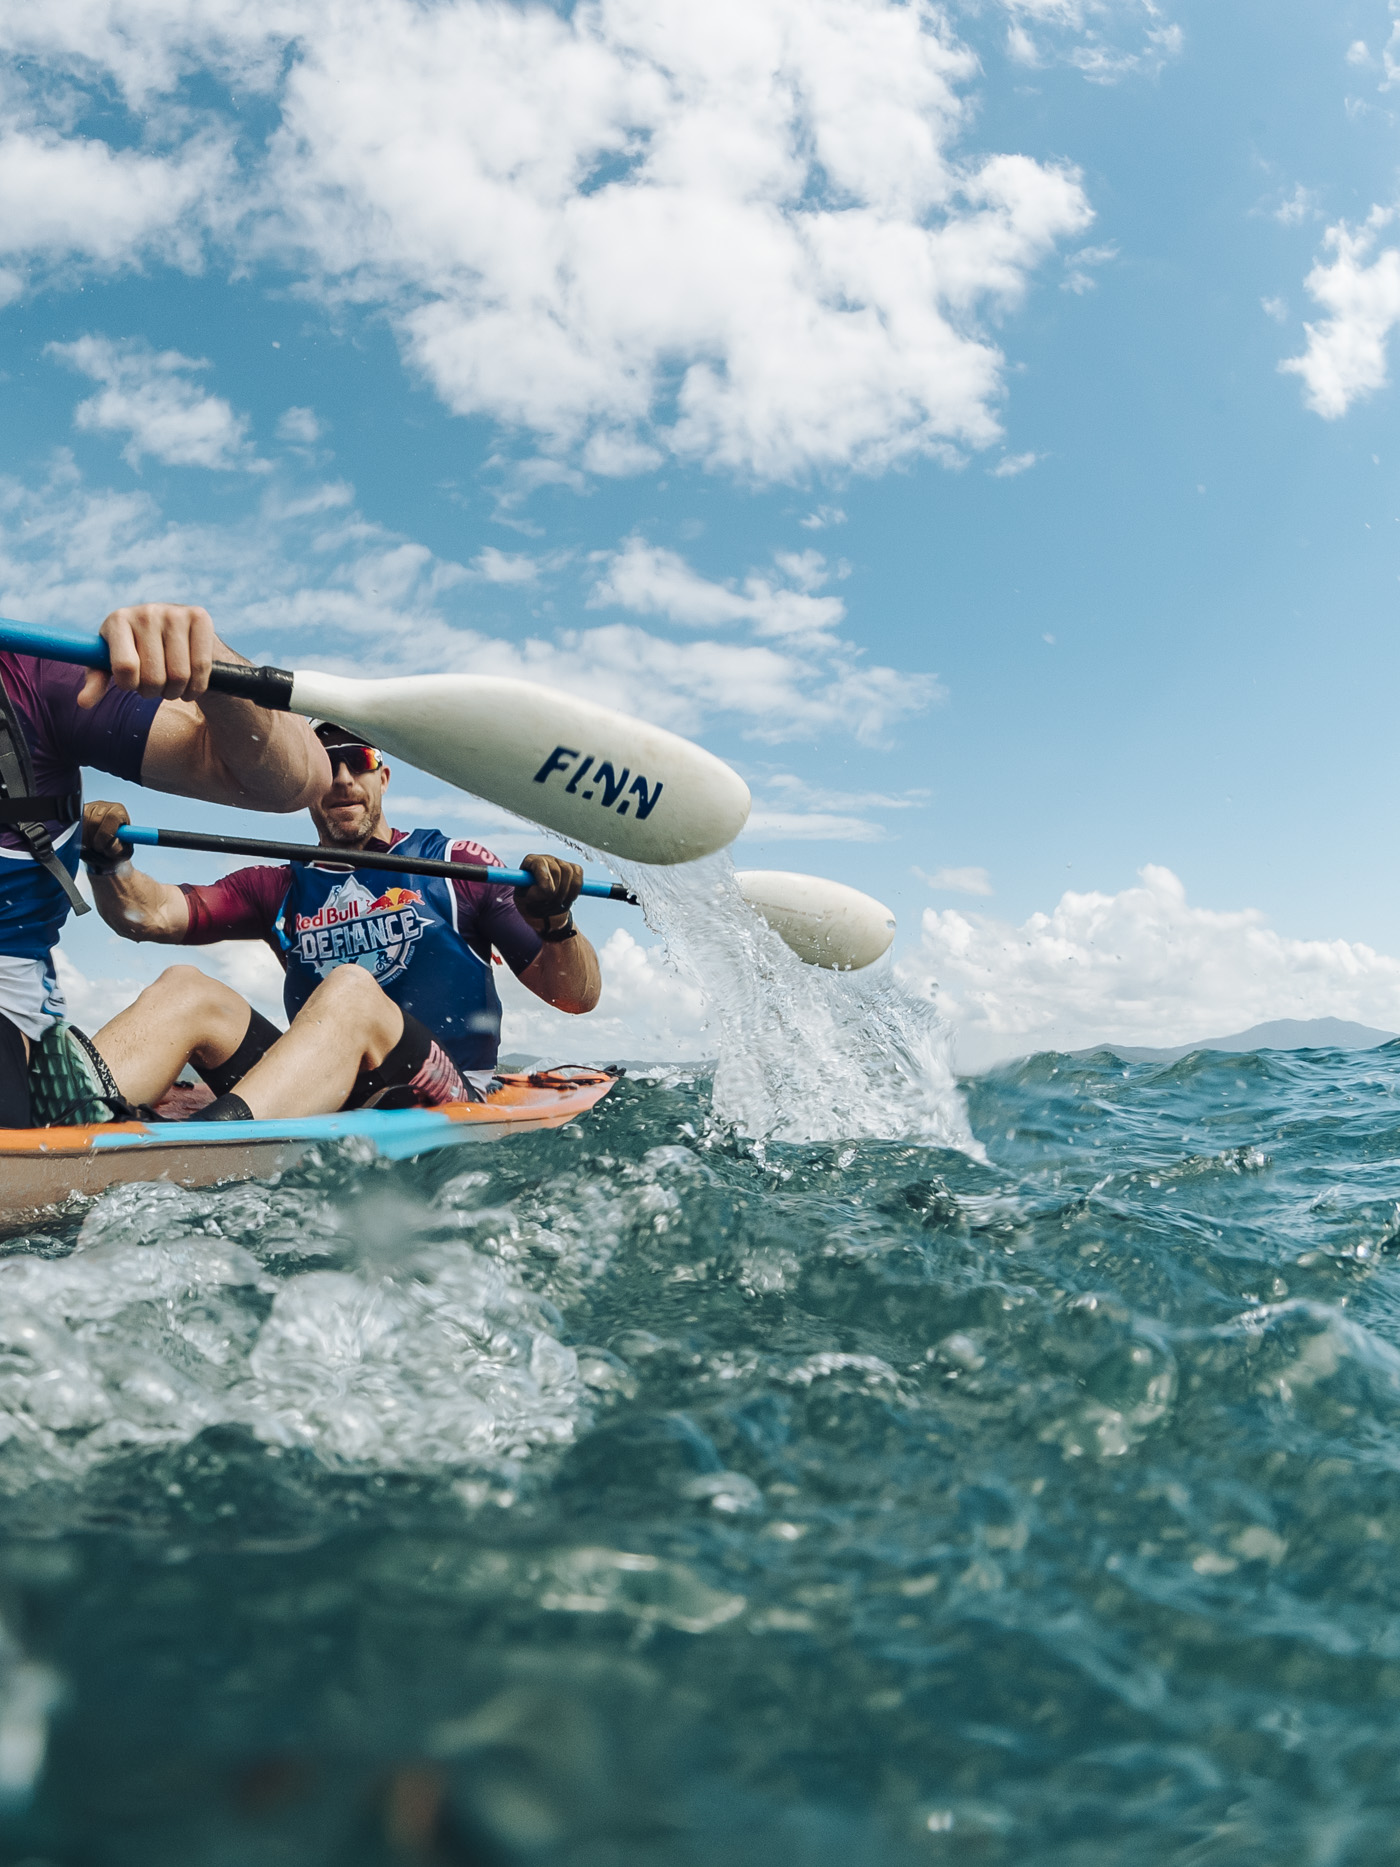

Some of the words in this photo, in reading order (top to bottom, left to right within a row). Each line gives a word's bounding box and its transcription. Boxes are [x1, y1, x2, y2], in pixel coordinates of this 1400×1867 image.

[533, 745, 663, 820] FINN
[301, 910, 420, 960] DEFIANCE
[326, 900, 359, 925] Bull
